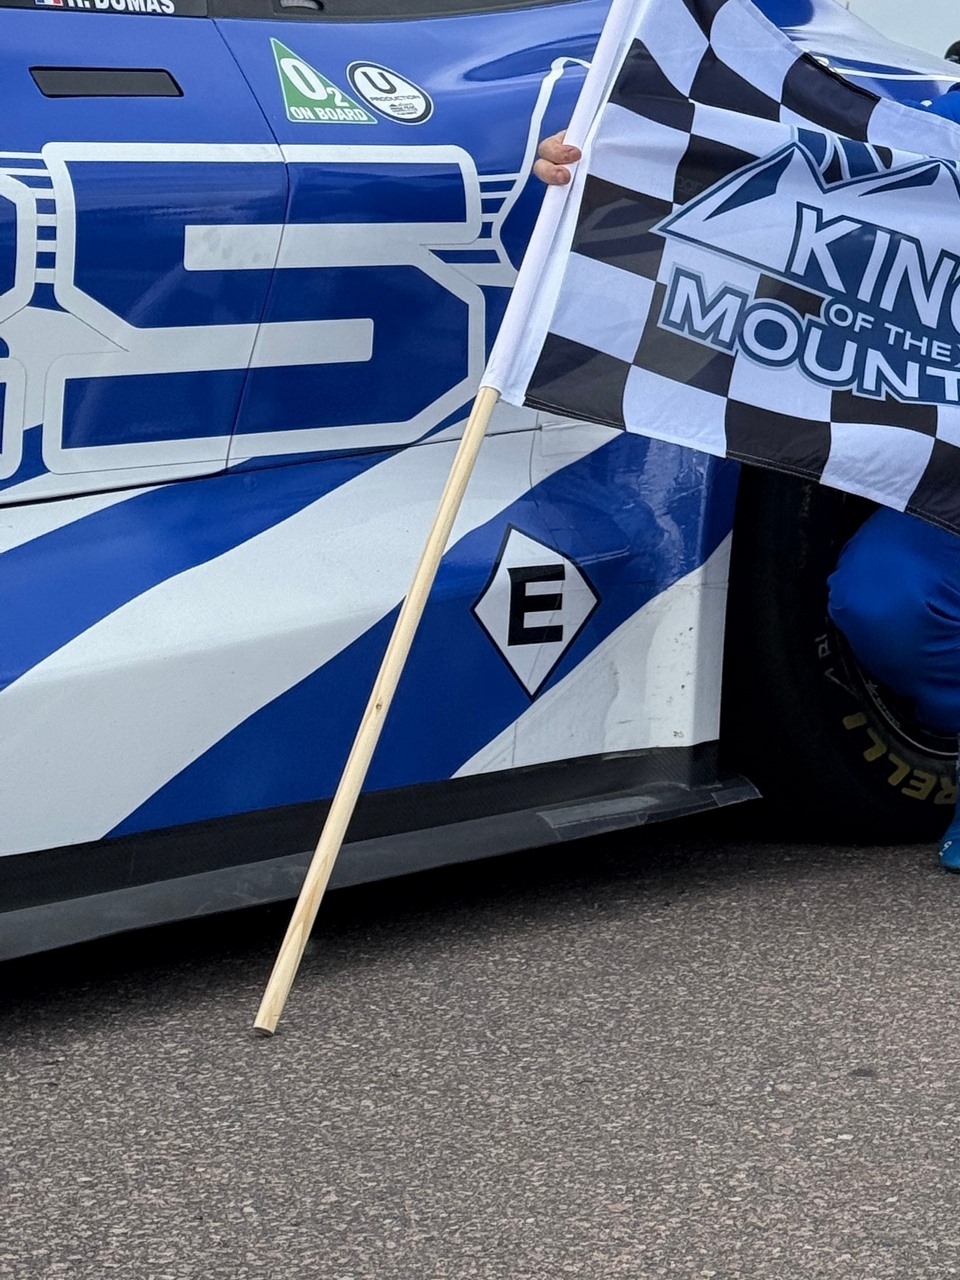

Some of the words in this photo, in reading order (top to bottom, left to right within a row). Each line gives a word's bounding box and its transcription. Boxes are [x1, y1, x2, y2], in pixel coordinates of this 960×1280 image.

[289, 106, 315, 120] ON
[314, 107, 369, 121] BOARD
[360, 71, 397, 94] U
[828, 299, 875, 330] OF
[882, 323, 952, 364] THE
[507, 564, 566, 646] E
[841, 710, 958, 806] RELLI
